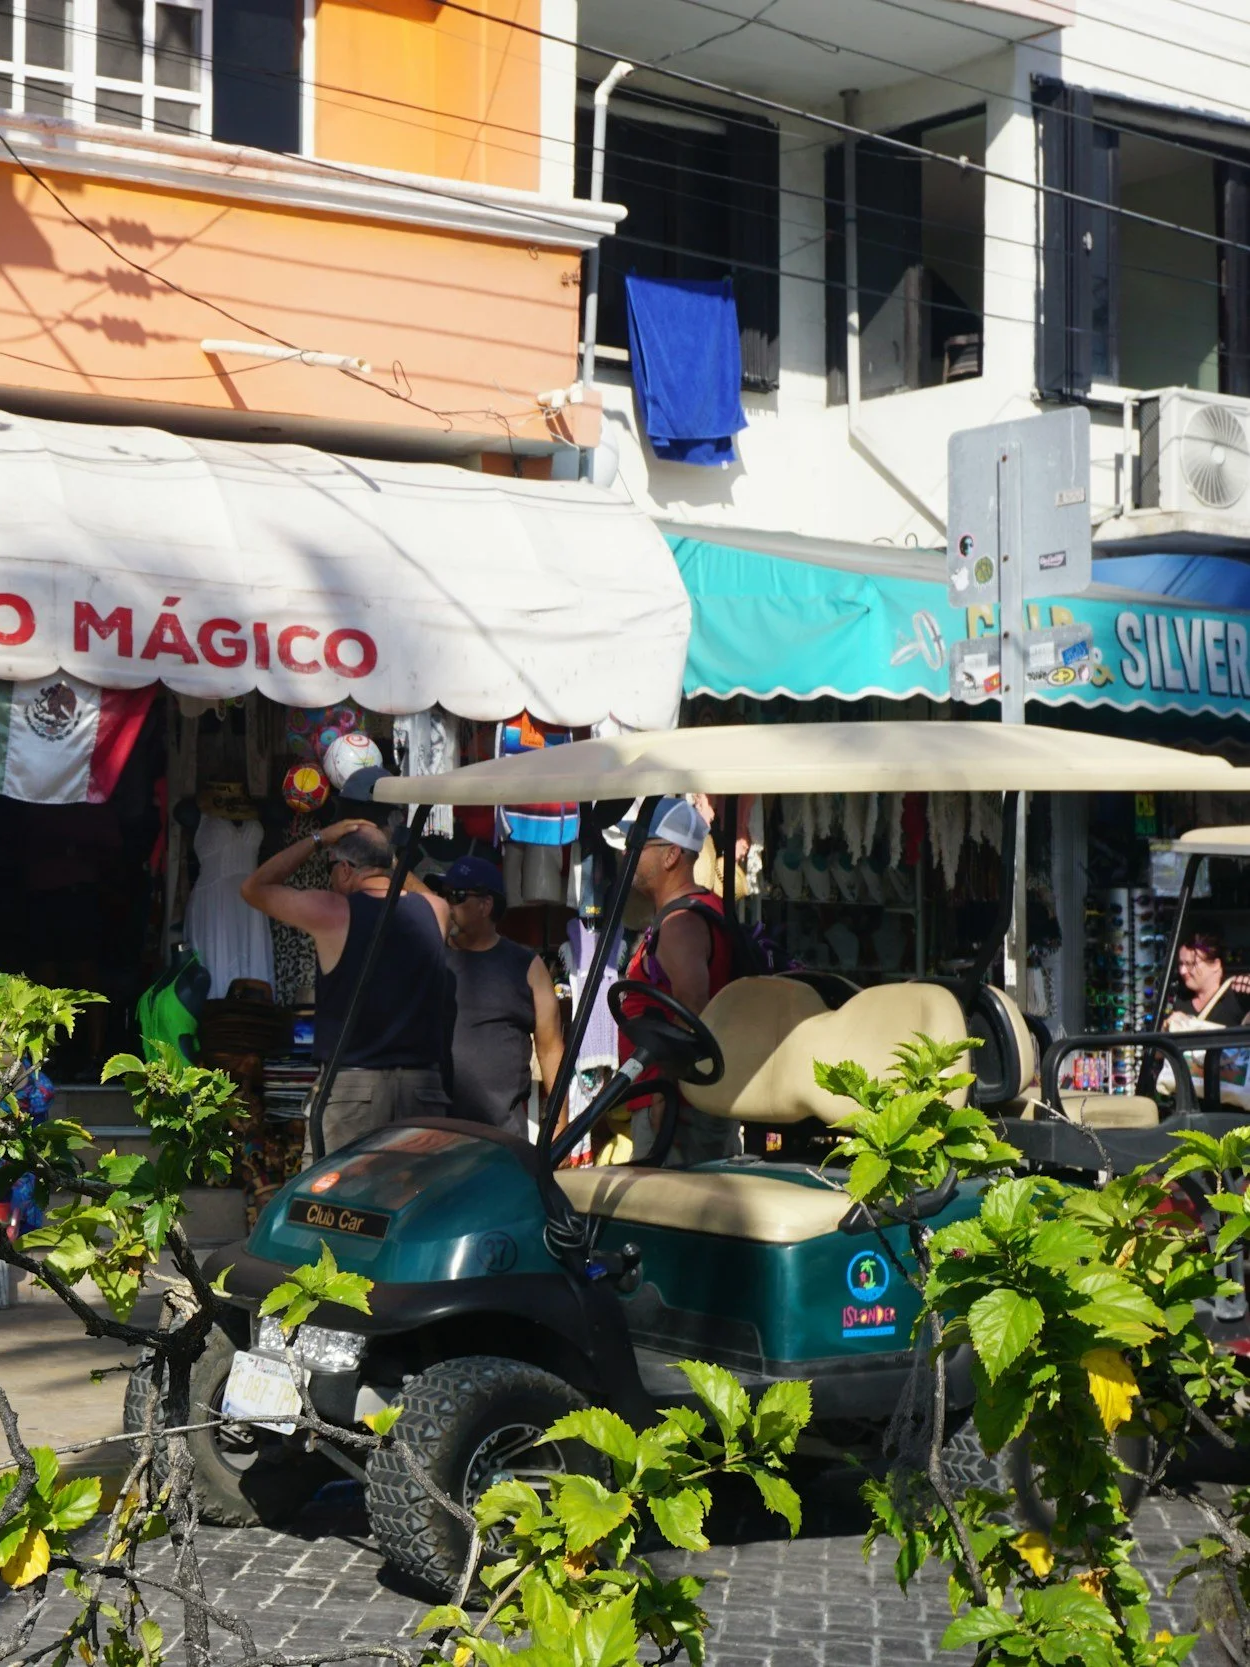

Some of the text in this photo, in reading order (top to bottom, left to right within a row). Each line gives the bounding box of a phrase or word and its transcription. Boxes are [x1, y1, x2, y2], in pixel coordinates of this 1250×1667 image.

[73, 596, 378, 679] MÁGICO
[1115, 611, 1250, 699] SILVER
[306, 1204, 365, 1232] Club Car
[485, 1238, 508, 1267] 37
